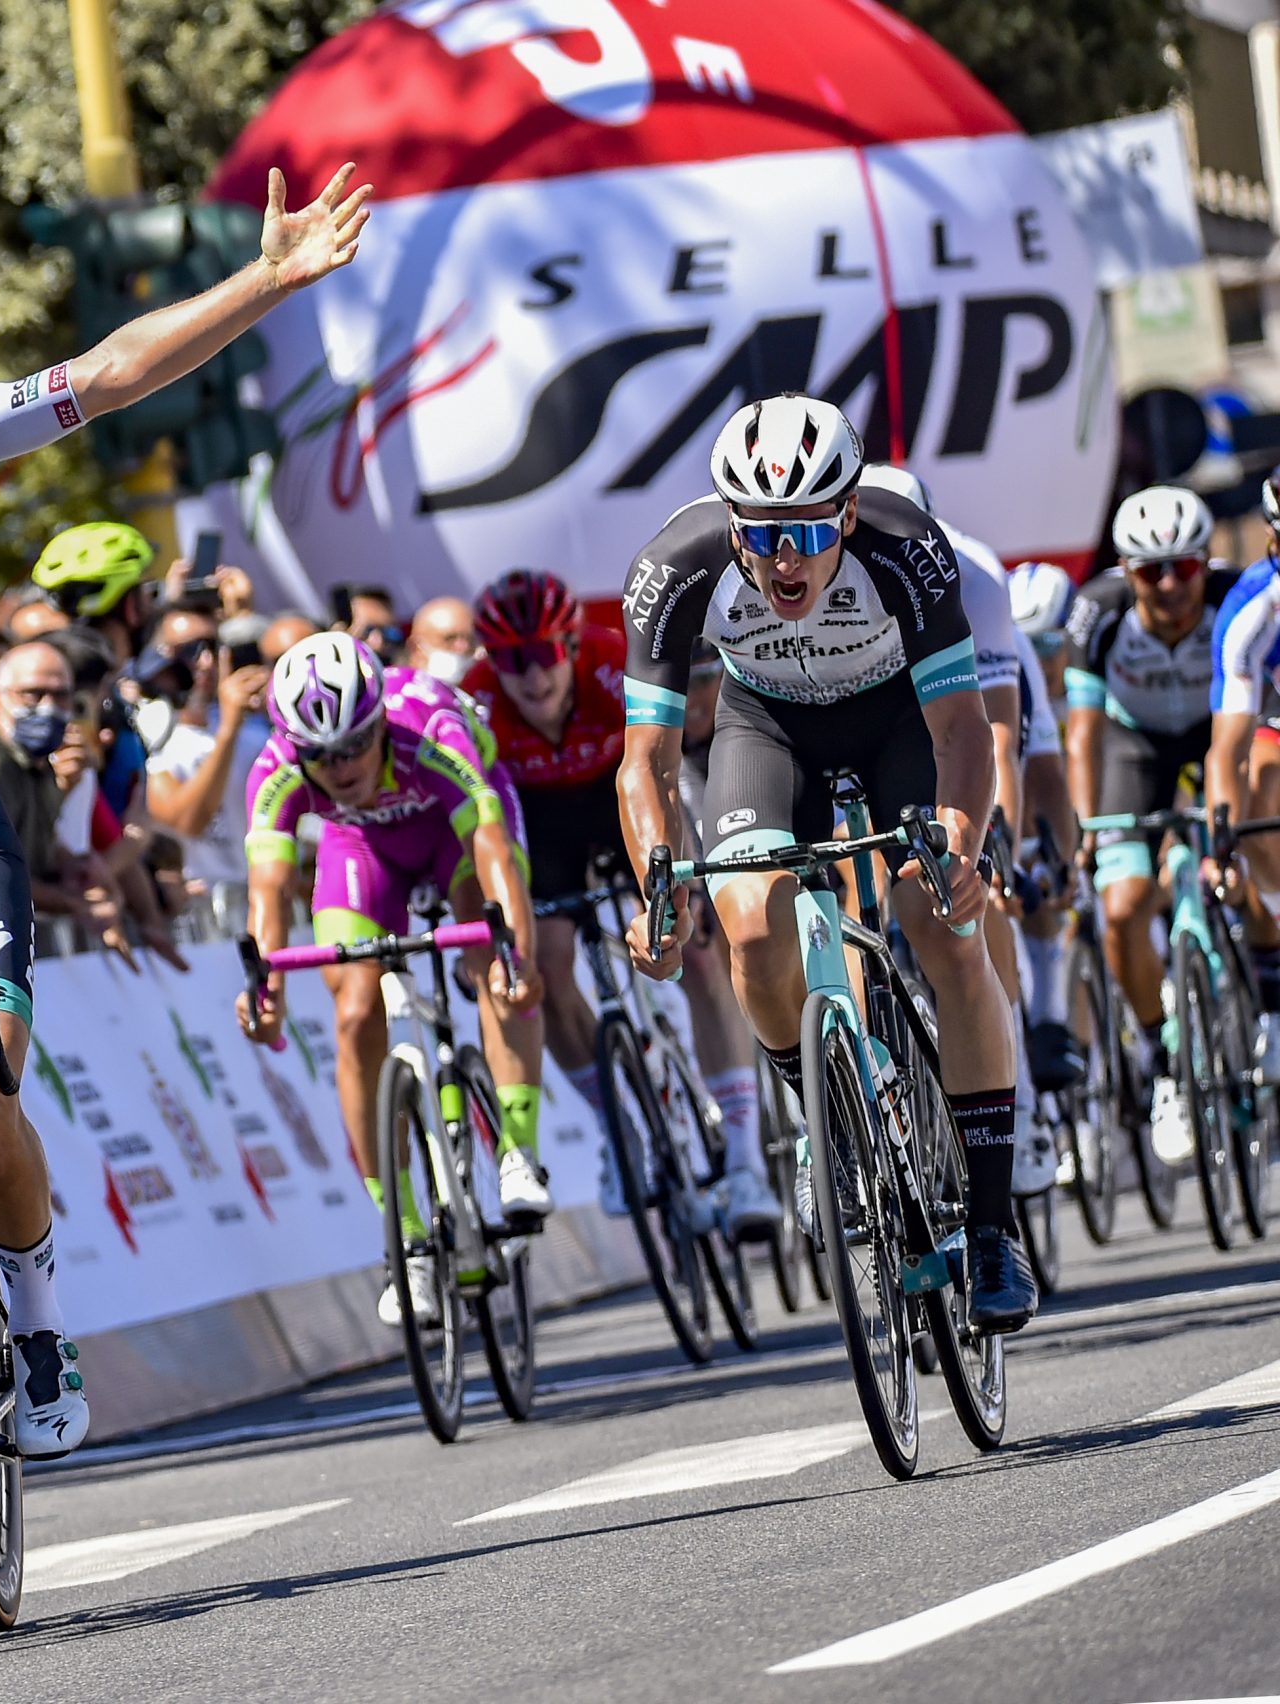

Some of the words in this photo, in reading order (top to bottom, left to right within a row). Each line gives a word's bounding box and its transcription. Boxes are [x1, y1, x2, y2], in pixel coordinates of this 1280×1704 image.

[522, 207, 1049, 309] SELLE
[419, 294, 1073, 514] SMP
[632, 564, 678, 635] ALULA
[870, 551, 925, 632] experiencealula.com
[900, 539, 946, 604] ALULA
[651, 568, 708, 660] experiencealula.com
[753, 622, 895, 661] EXCHANGE
[753, 635, 815, 653] BIKE
[817, 618, 870, 628] Jayco
[963, 1126, 991, 1138] BIKE
